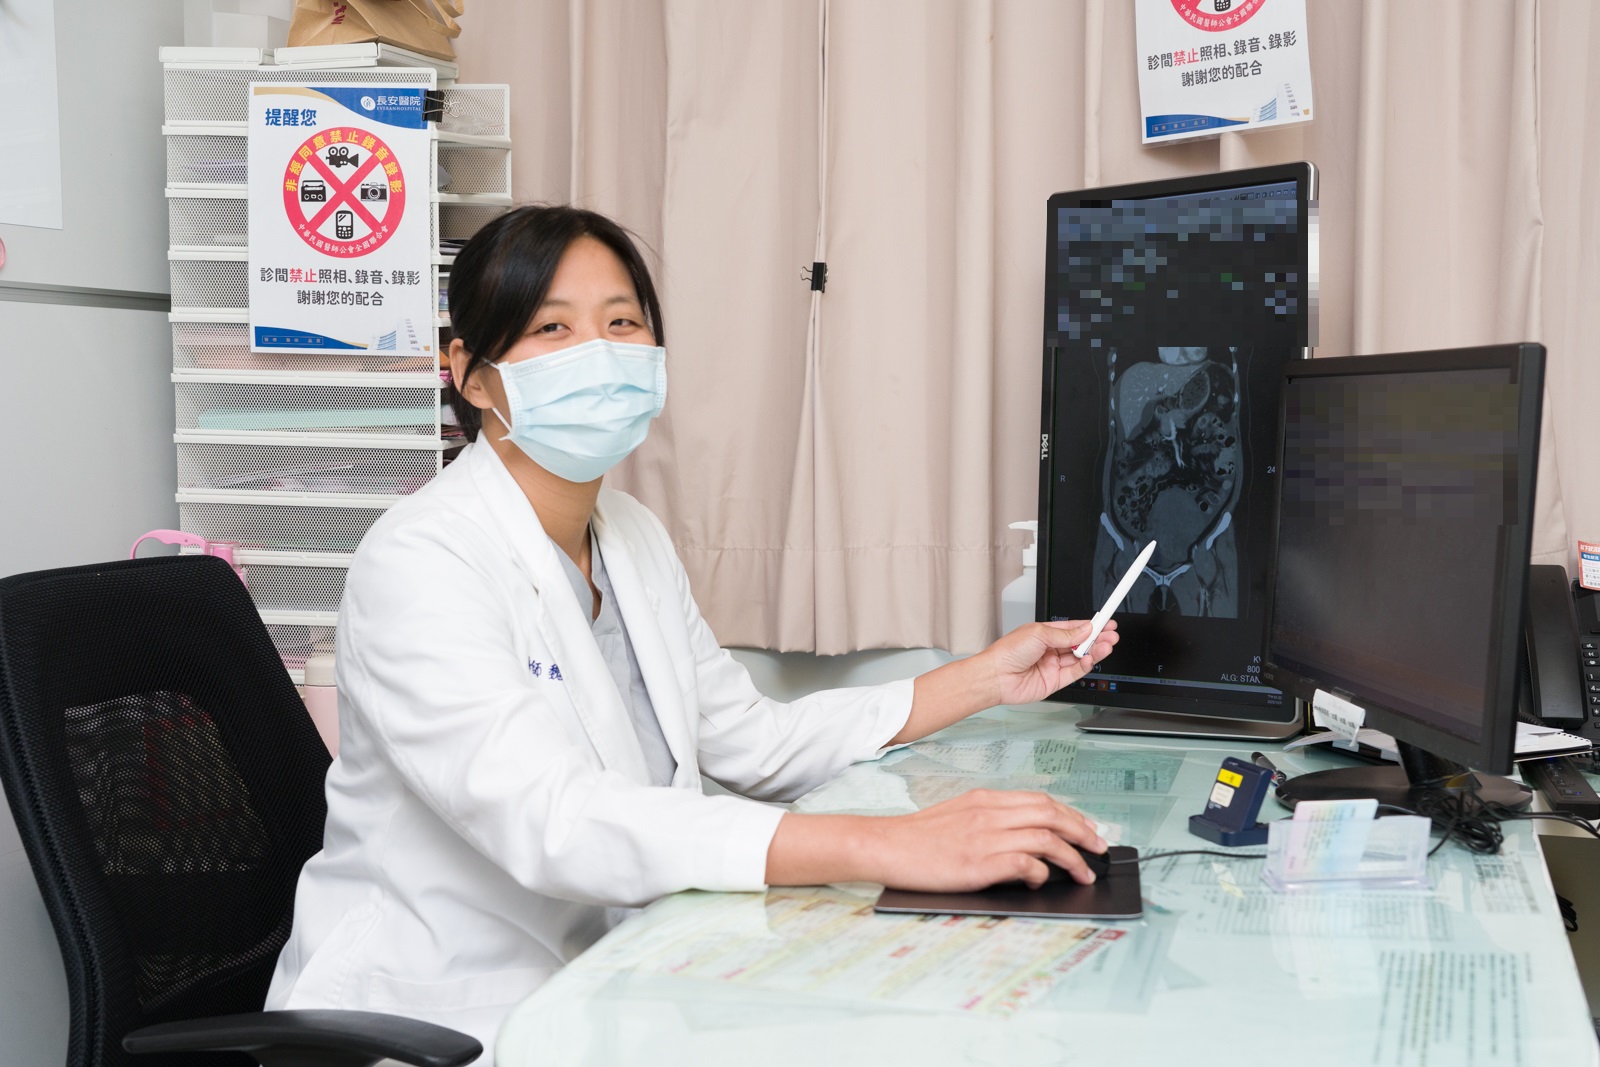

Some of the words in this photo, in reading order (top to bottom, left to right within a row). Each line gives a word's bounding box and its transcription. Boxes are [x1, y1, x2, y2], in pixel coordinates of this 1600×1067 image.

[1147, 30, 1297, 71] 診間禁止照相、錄音、錄影
[1181, 60, 1263, 87] 謝謝您的配合
[376, 95, 421, 106] 長安醫院
[265, 108, 317, 127] 提醒您
[285, 130, 402, 193] 非經同意禁止錄音錄影
[260, 267, 421, 286] 診間禁止照相、錄音、錄影
[297, 290, 384, 307] 謝謝您的配合
[1041, 433, 1049, 460] DELL
[1060, 474, 1066, 482] R
[1158, 664, 1163, 673] F
[1240, 674, 1263, 684] STAN
